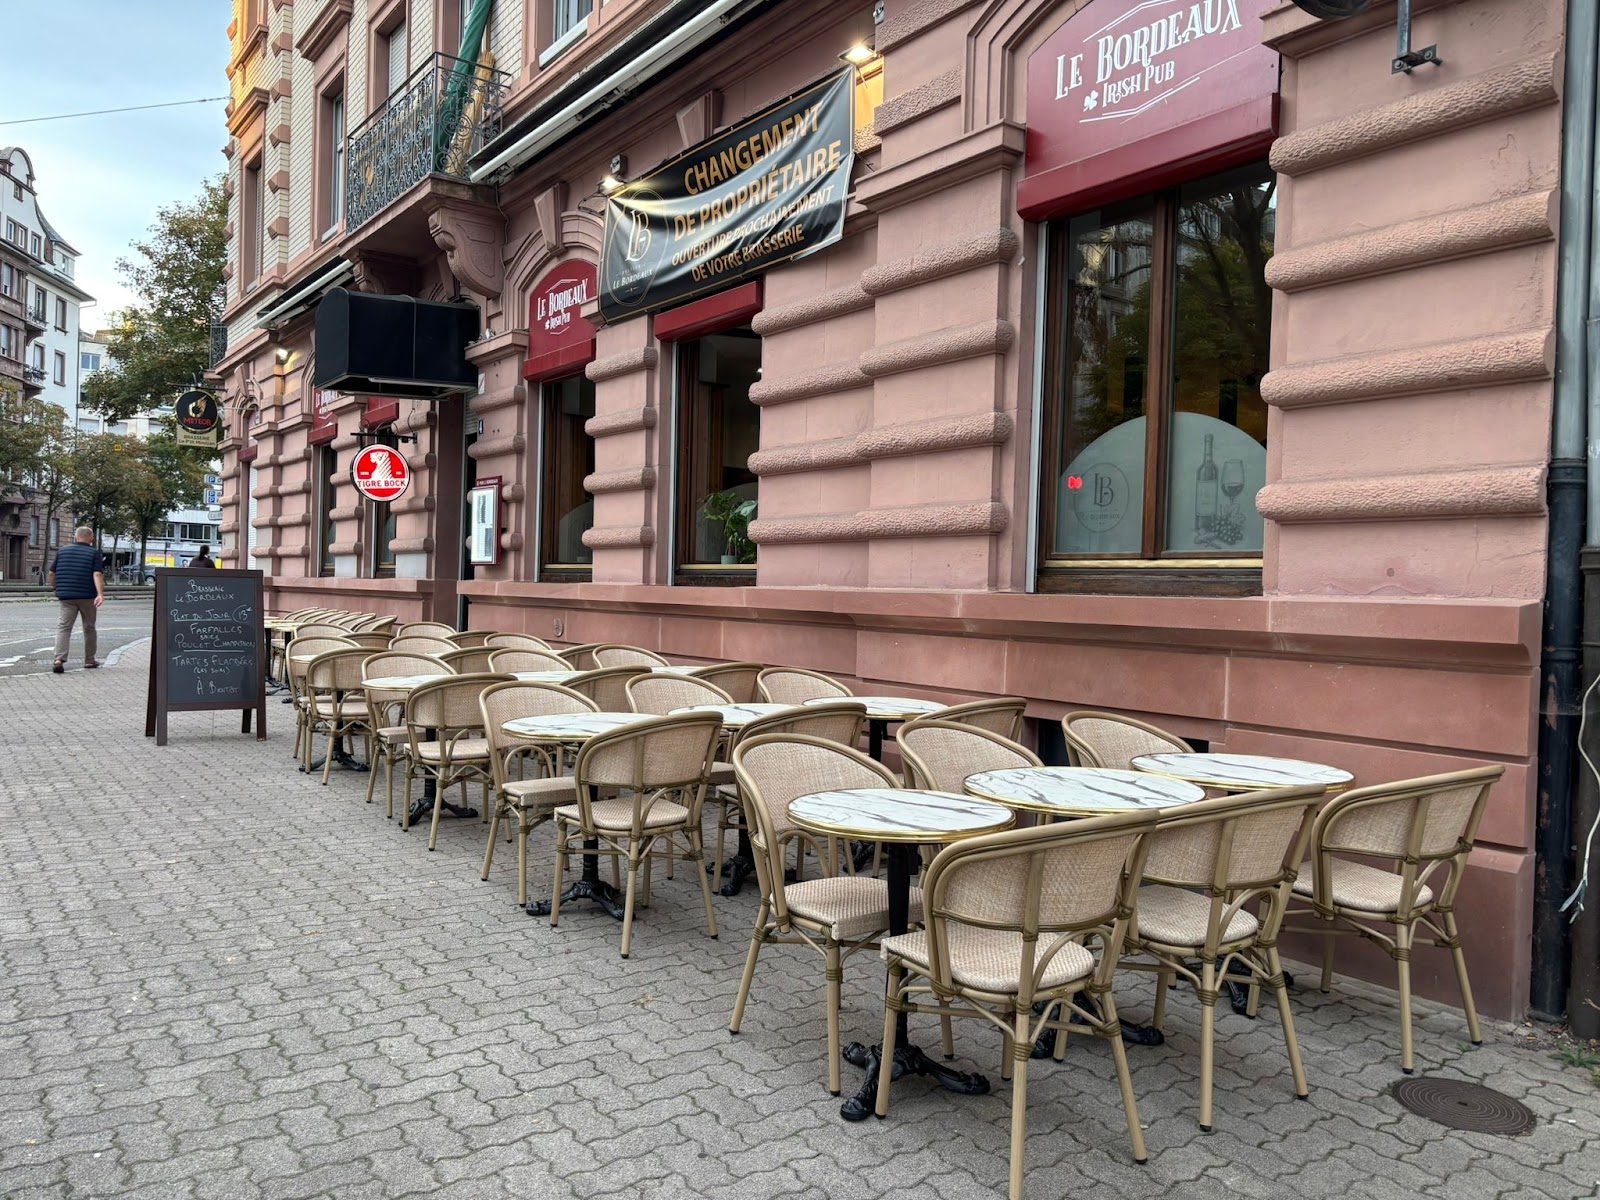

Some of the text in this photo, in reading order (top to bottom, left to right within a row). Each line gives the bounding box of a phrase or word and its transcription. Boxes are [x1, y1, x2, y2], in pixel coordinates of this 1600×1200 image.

[1055, 0, 1242, 100] LE BORDEAUX
[1102, 61, 1175, 107] IRISH PUB
[684, 103, 822, 195] CHANGEMENT
[674, 140, 841, 242] DE PROPRIÉTAIRE
[734, 185, 834, 240] PROCHAINEMENT
[691, 223, 804, 282] DE VOTRE BRASSERIE
[537, 278, 588, 320] LE BORDEAUX
[183, 416, 212, 427] METEOR
[185, 591, 234, 603] BORDEAUX
[172, 655, 209, 667] TARTES
[175, 633, 210, 648] POULET
